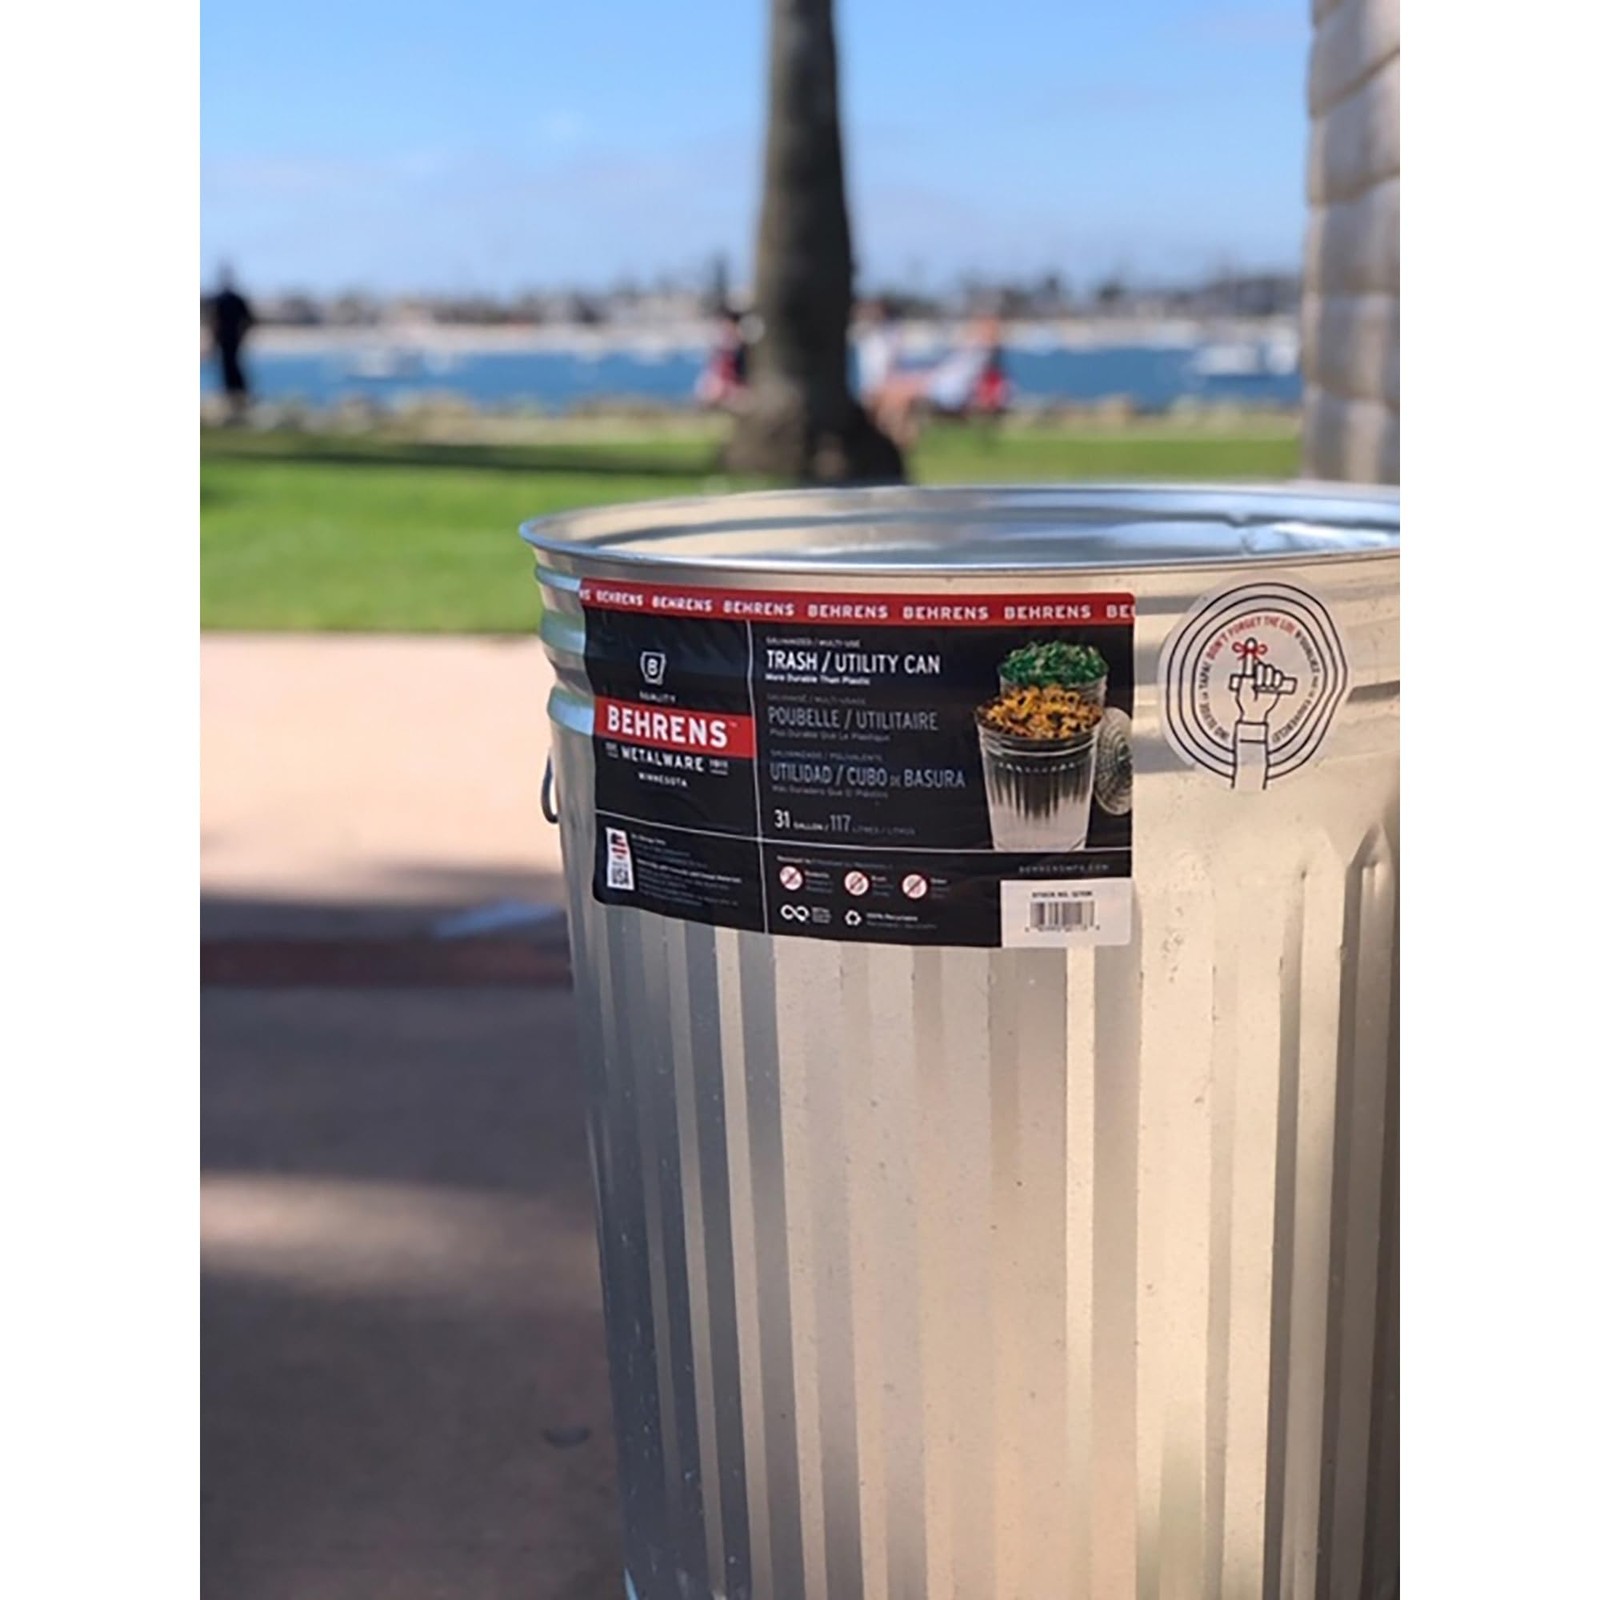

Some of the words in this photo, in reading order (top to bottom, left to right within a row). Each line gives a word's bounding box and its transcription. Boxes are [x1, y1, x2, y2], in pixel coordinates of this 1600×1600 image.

[651, 594, 713, 613] BEHRENS
[723, 599, 795, 617] BEHRENS
[807, 603, 889, 620] BEHRENS
[902, 604, 989, 620] BEHRENS
[1003, 604, 1091, 620] BEHRENS
[766, 649, 818, 671] TRASH
[834, 653, 899, 674] UTILITY
[904, 654, 941, 674] CAN
[607, 704, 728, 748] BEHRENS
[767, 706, 841, 728] POUBELLE
[856, 710, 939, 732] UTILITAIRE
[620, 744, 705, 772] METALWARE
[769, 762, 833, 784] UTILIDAD
[846, 766, 888, 787] CUBO
[903, 768, 967, 788] BASURA
[774, 808, 791, 828] 31
[829, 813, 852, 833] 117
